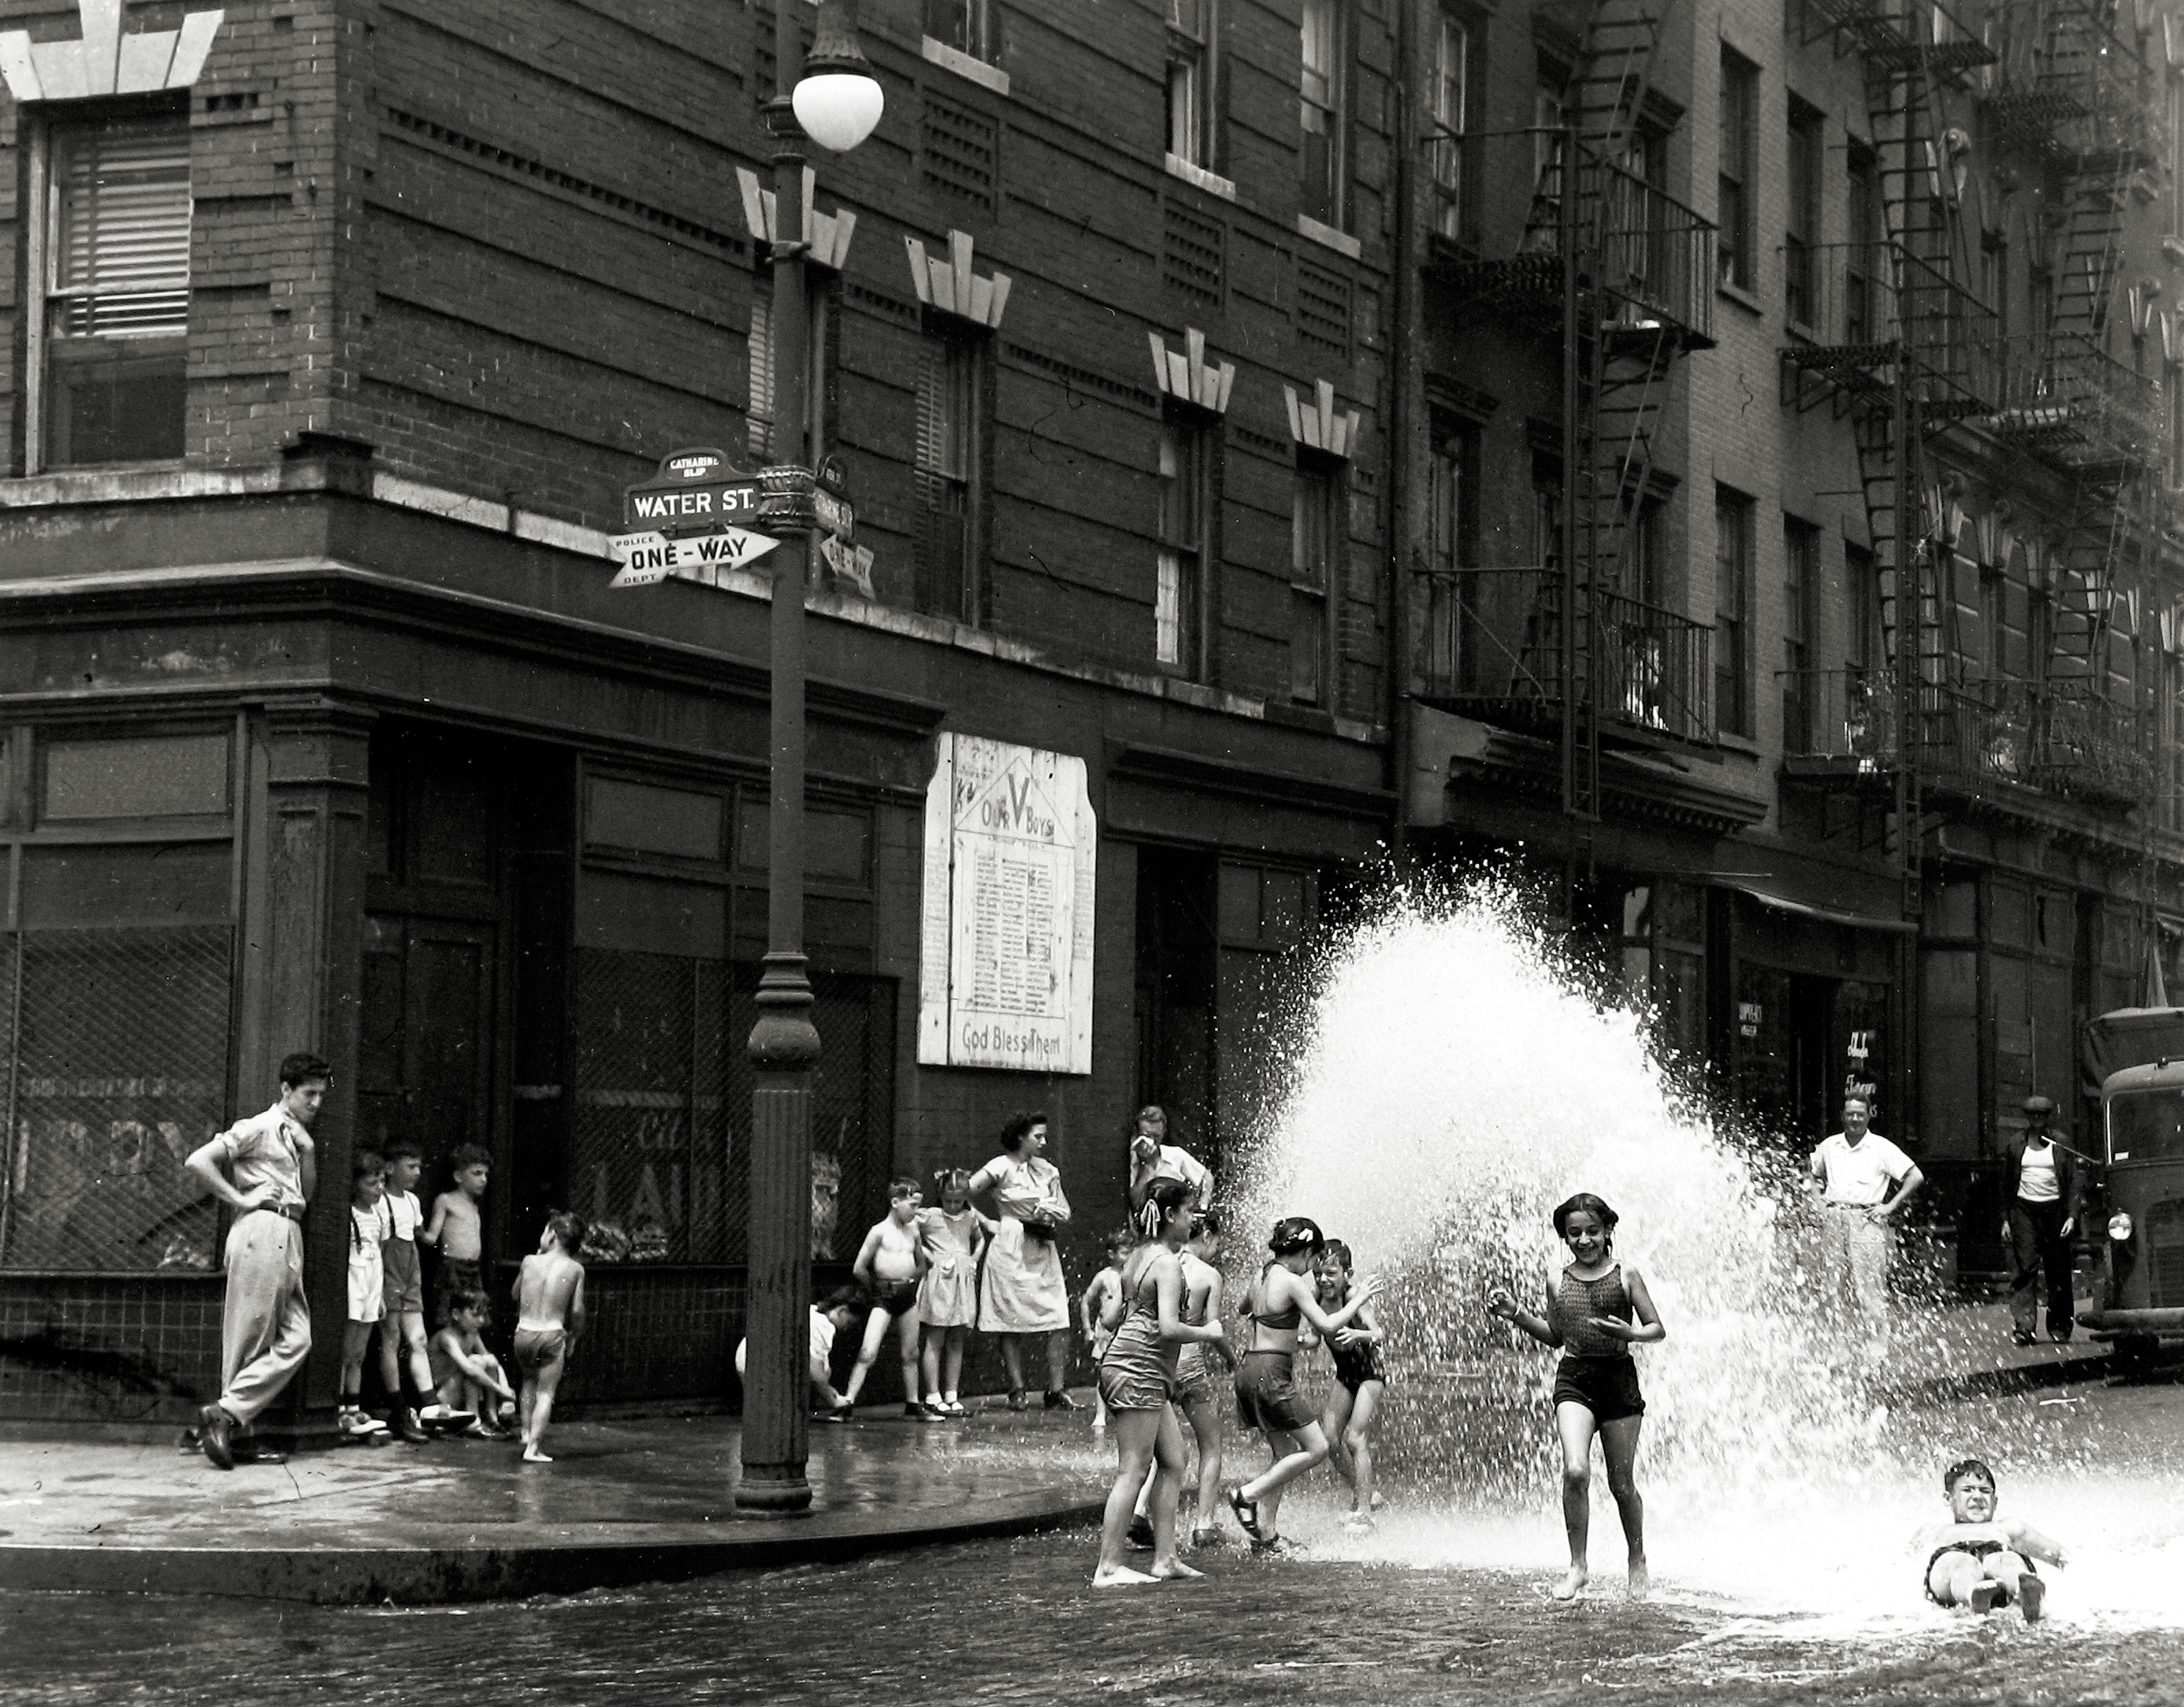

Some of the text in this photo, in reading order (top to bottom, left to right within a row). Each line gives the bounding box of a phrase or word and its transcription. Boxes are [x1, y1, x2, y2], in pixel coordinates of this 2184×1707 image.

[670, 456, 720, 470] CATHARINE
[683, 467, 707, 478] SLIP
[633, 488, 755, 518] WATER ST.
[615, 536, 656, 548] POLICE
[631, 537, 748, 570] ONE-WAY
[624, 573, 657, 585] DEPT
[1008, 773, 1031, 831] V
[962, 1022, 1060, 1058] God Bless Them
